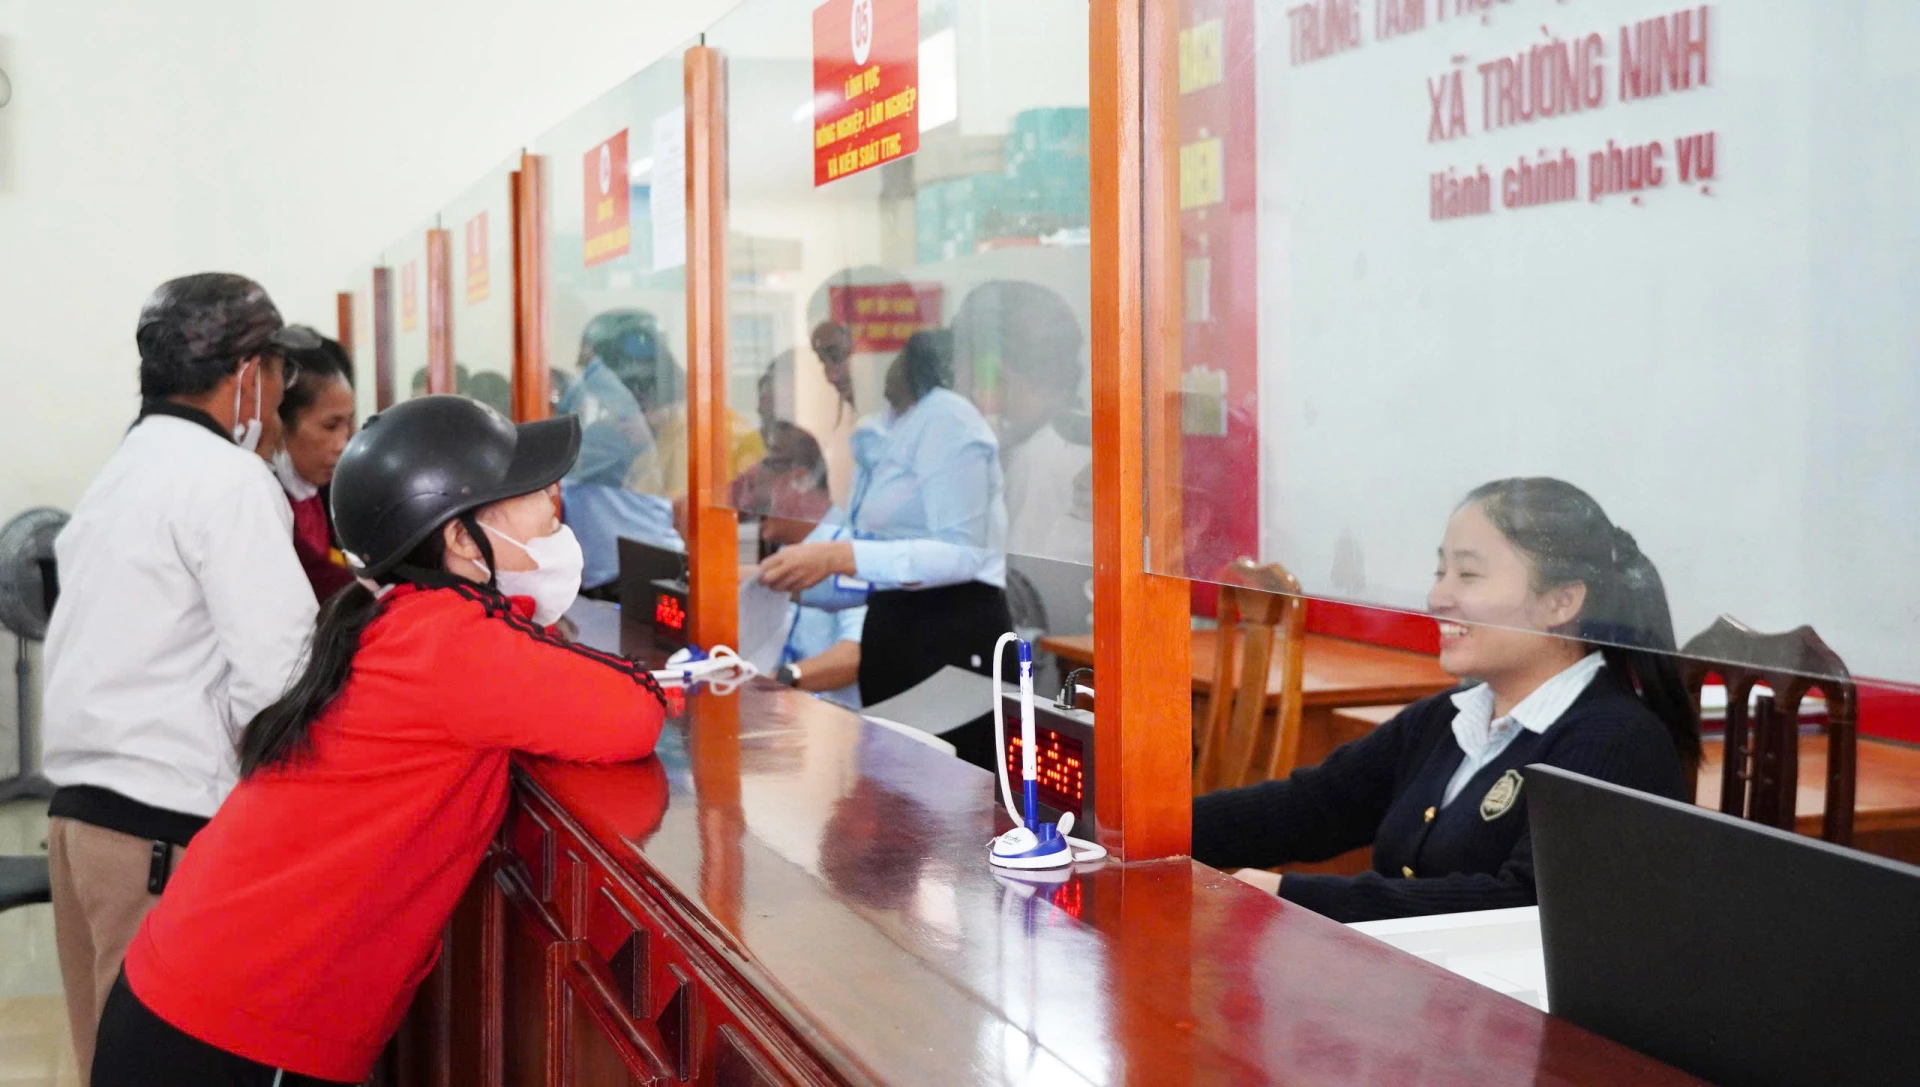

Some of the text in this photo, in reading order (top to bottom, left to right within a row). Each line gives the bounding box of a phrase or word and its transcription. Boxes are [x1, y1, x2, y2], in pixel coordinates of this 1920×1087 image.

[854, 1, 869, 48] 05
[1427, 4, 1708, 143] XÃ TRƯỜNG NINH
[1429, 131, 1715, 220] Hành chính phục vụ
